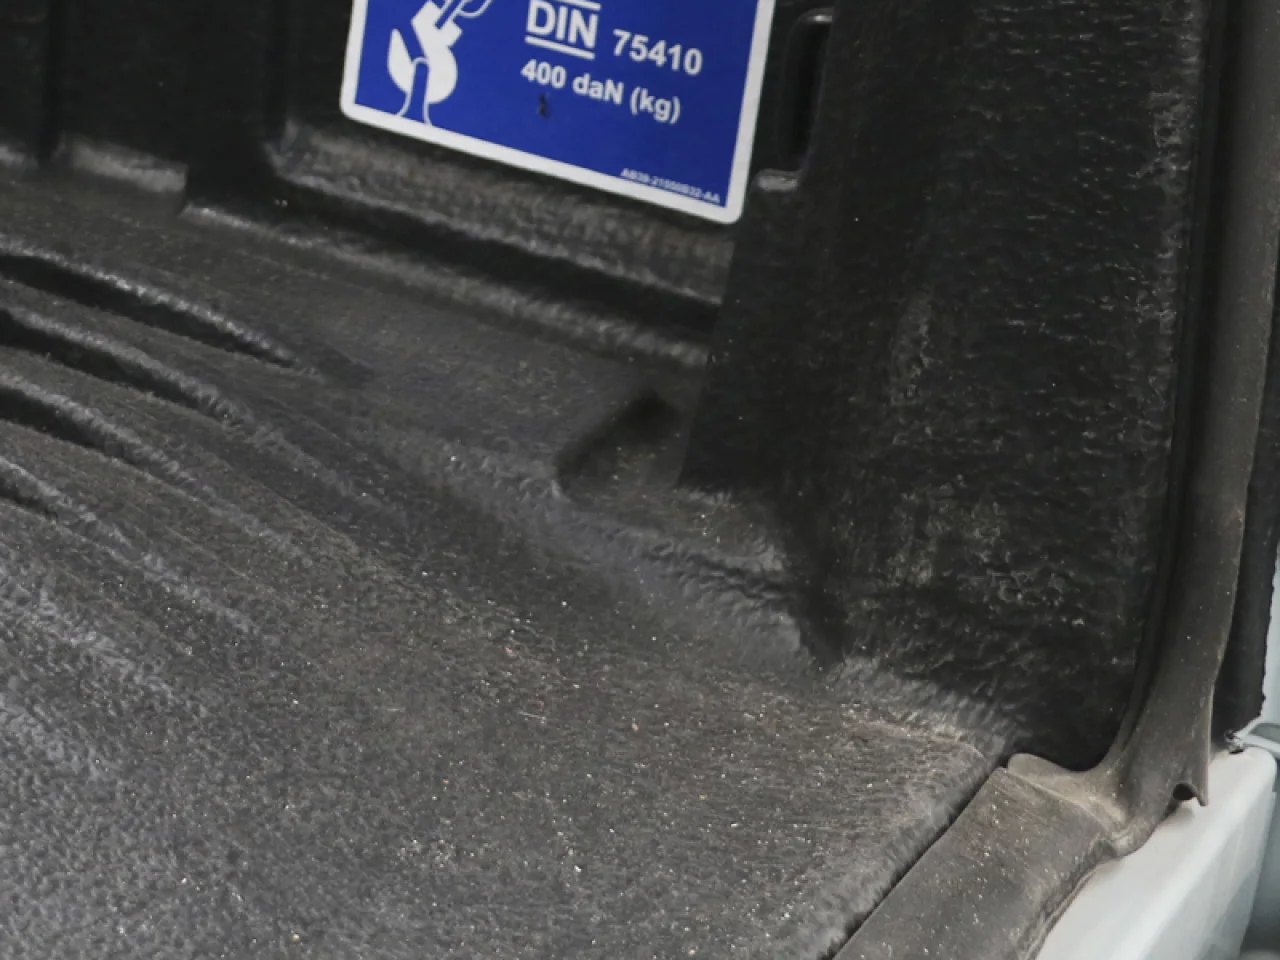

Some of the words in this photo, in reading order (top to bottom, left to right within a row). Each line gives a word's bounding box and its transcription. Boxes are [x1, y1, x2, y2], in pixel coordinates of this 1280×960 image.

[613, 28, 704, 76] 75410
[521, 58, 567, 89] 400
[572, 73, 624, 105] daN
[630, 86, 681, 125] (kg)
